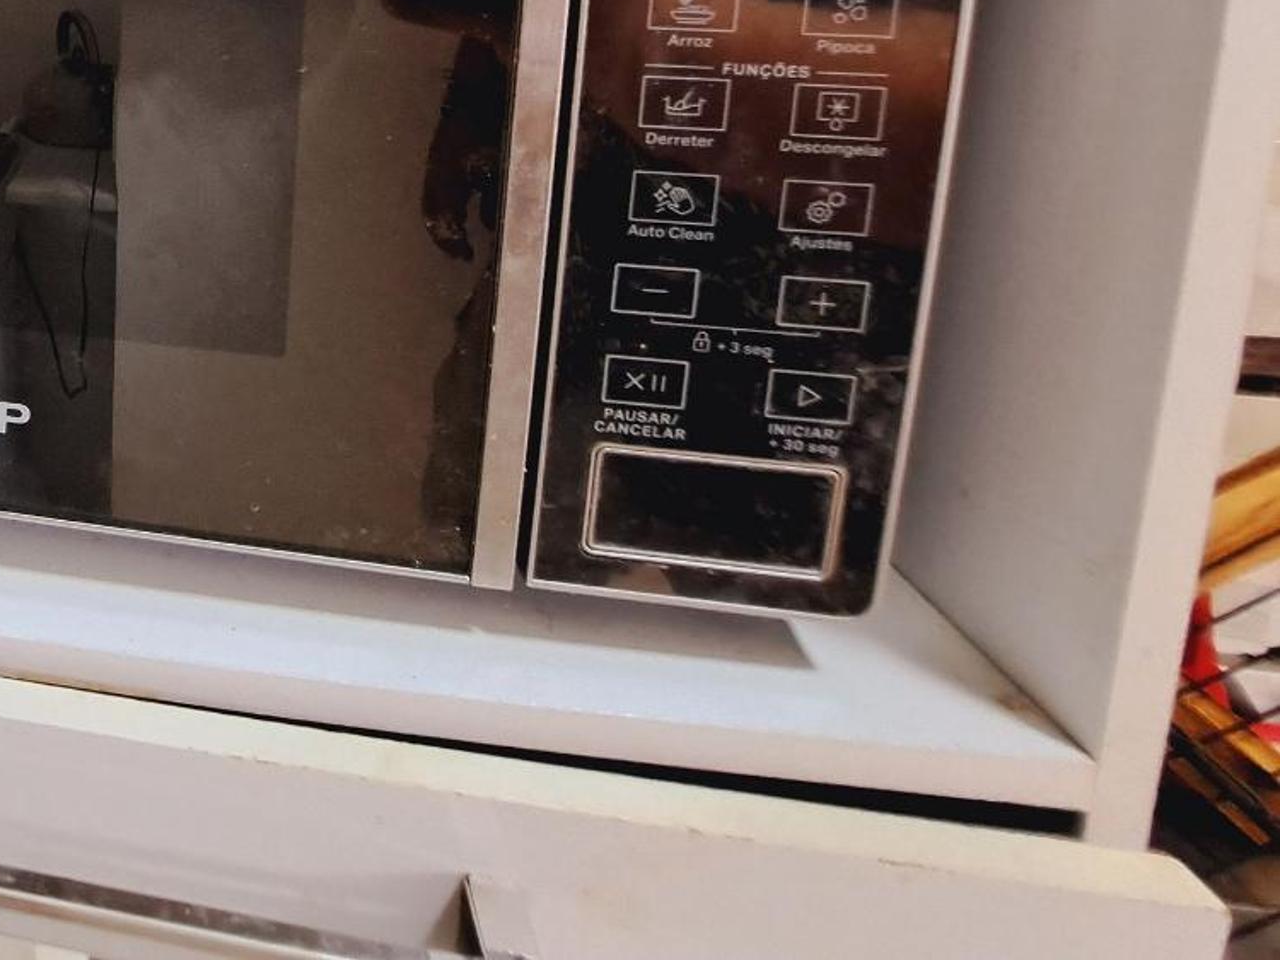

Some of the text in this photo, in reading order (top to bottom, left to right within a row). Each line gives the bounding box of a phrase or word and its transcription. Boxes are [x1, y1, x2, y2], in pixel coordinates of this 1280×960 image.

[667, 34, 714, 48] Arroz
[817, 40, 876, 55] Pipoca
[722, 61, 811, 80] FUNÇÕES
[645, 132, 714, 147] Derreter
[780, 139, 887, 159] Descongelar
[628, 224, 714, 241] Auto Clean
[791, 236, 853, 252] Ajustes
[729, 342, 740, 353] 3
[603, 407, 679, 425] PAUSAR/
[594, 421, 687, 440] CANCELAR
[768, 423, 843, 440] INICIAR/
[782, 439, 804, 452] 30
[808, 442, 840, 457] seg
